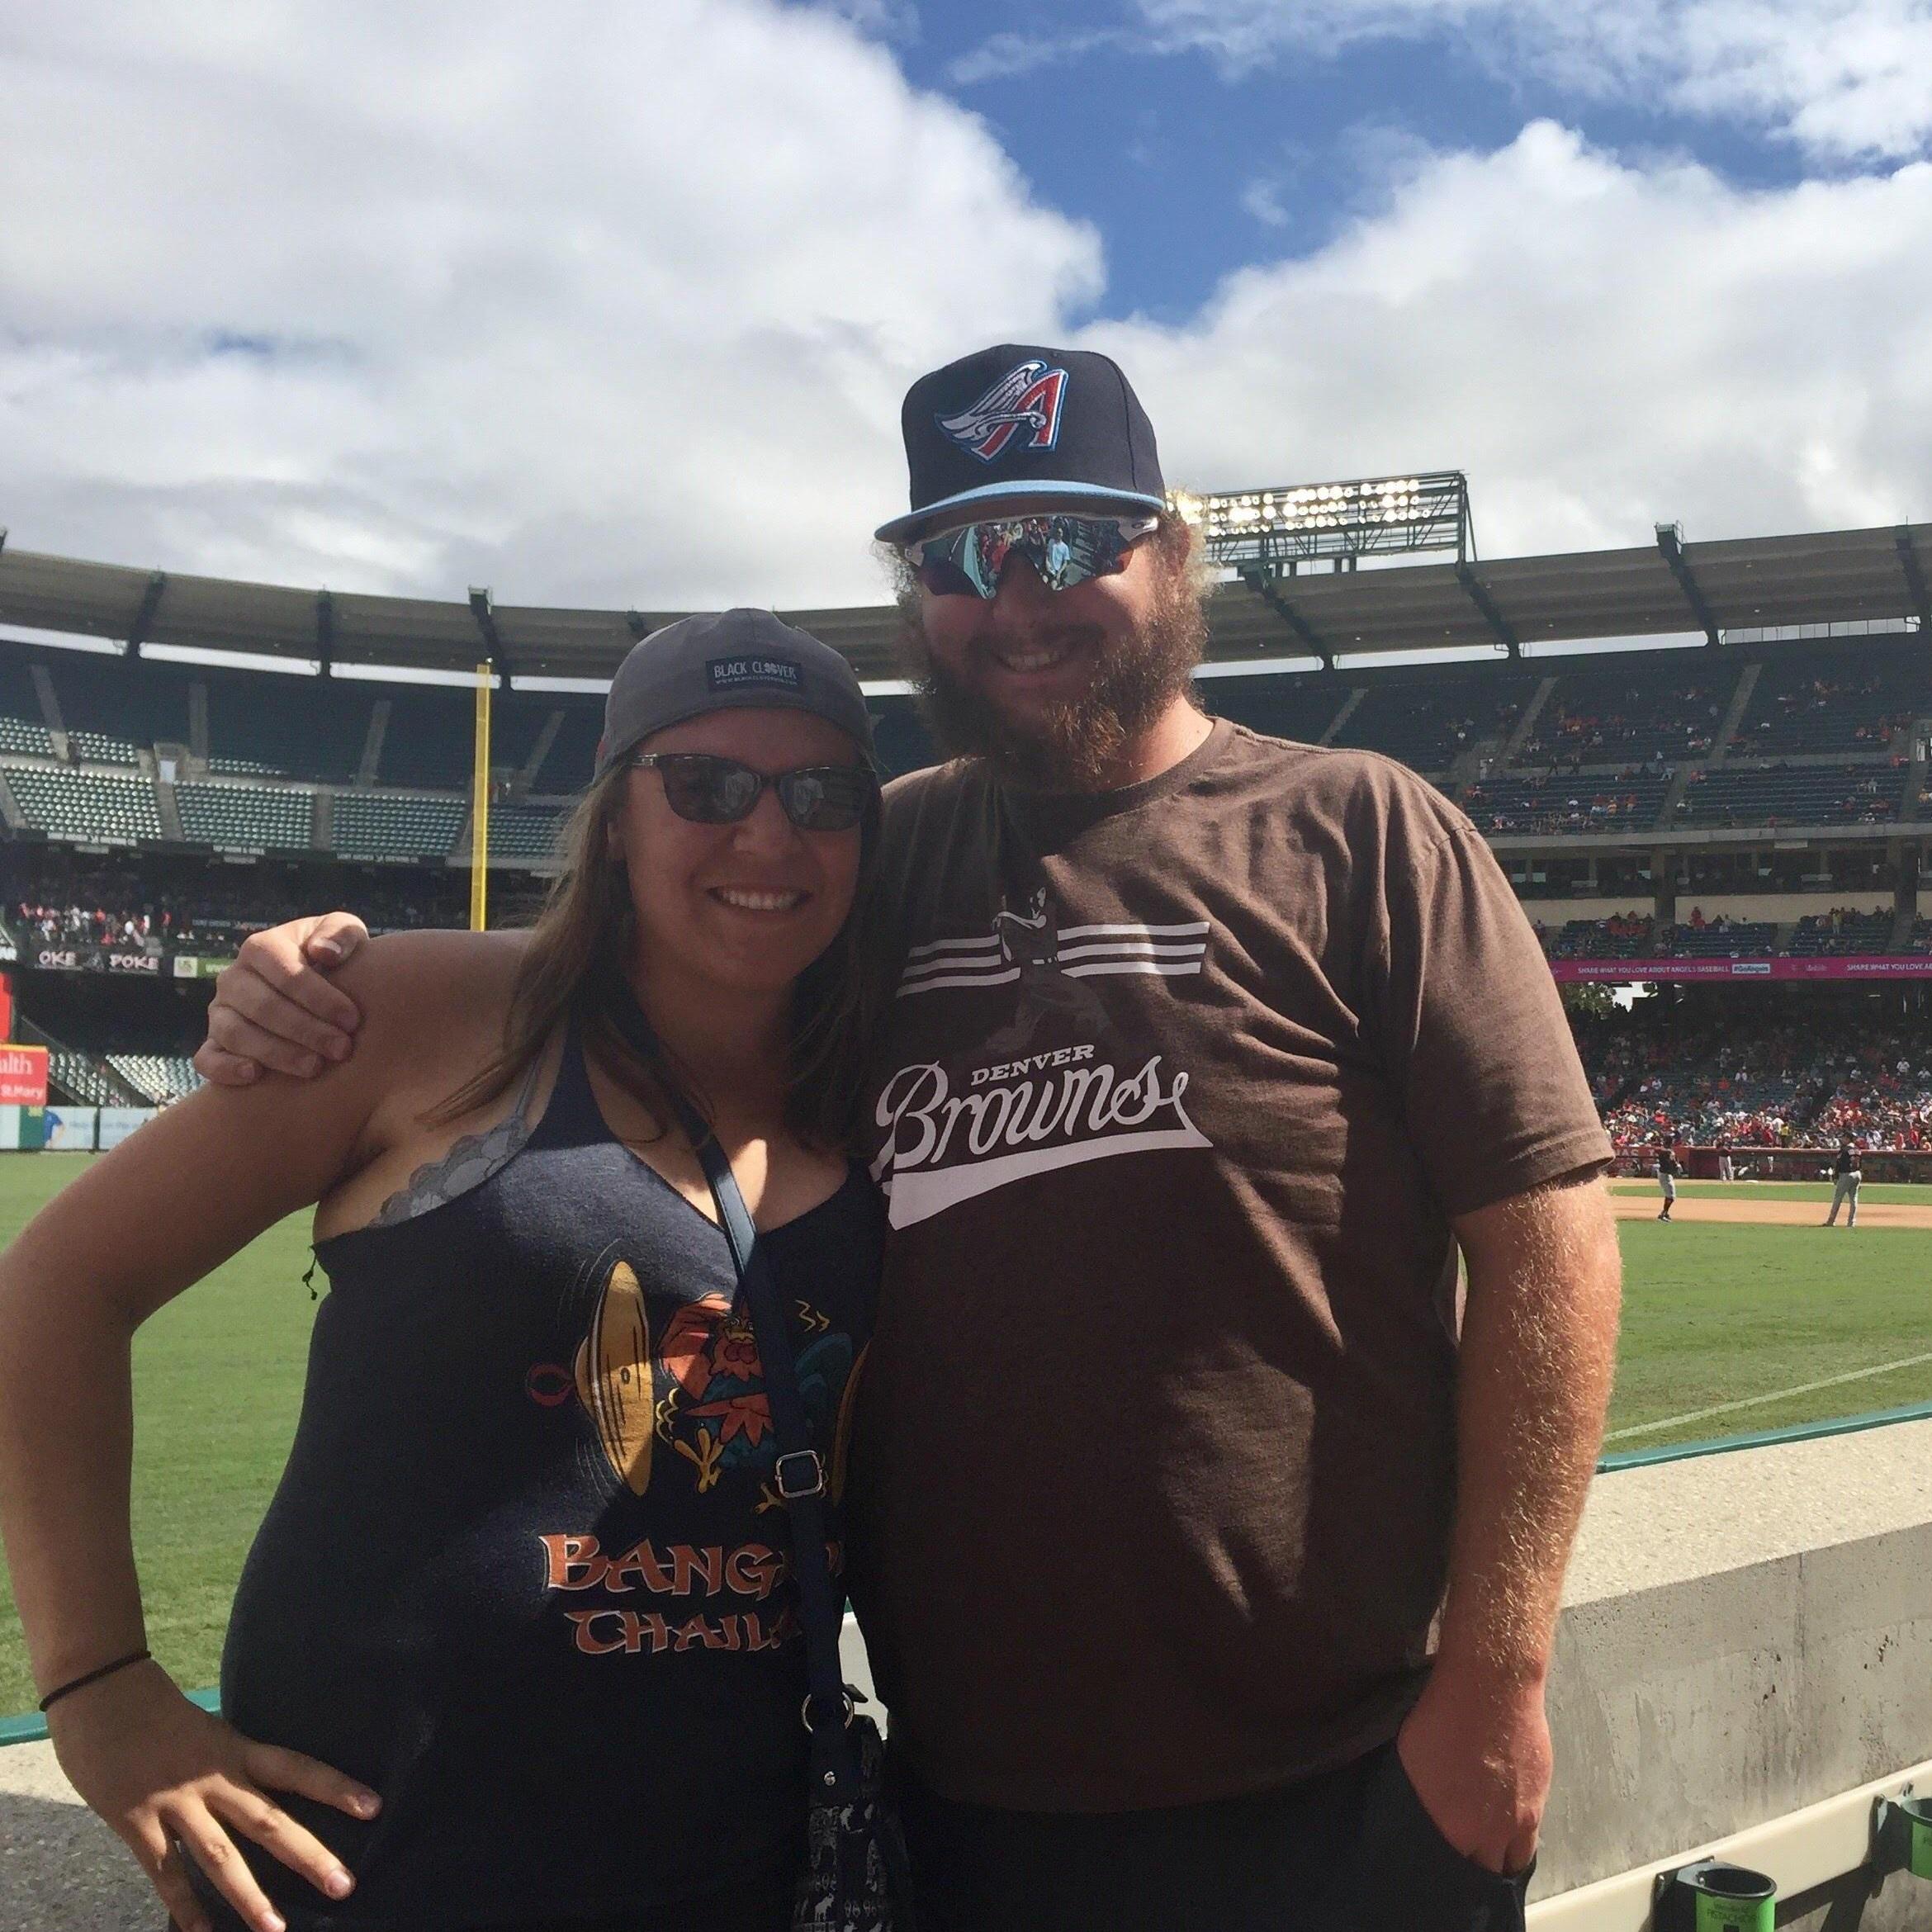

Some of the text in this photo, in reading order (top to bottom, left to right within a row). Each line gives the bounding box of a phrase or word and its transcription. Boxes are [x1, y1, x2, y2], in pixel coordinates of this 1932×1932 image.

[714, 661, 747, 678] BLACK
[109, 954, 159, 970] POKE
[1698, 965, 1730, 973] BASEBALL
[971, 1044, 1095, 1086] DENVER
[869, 1055, 1191, 1174] Browns
[538, 1533, 841, 1601] BANG
